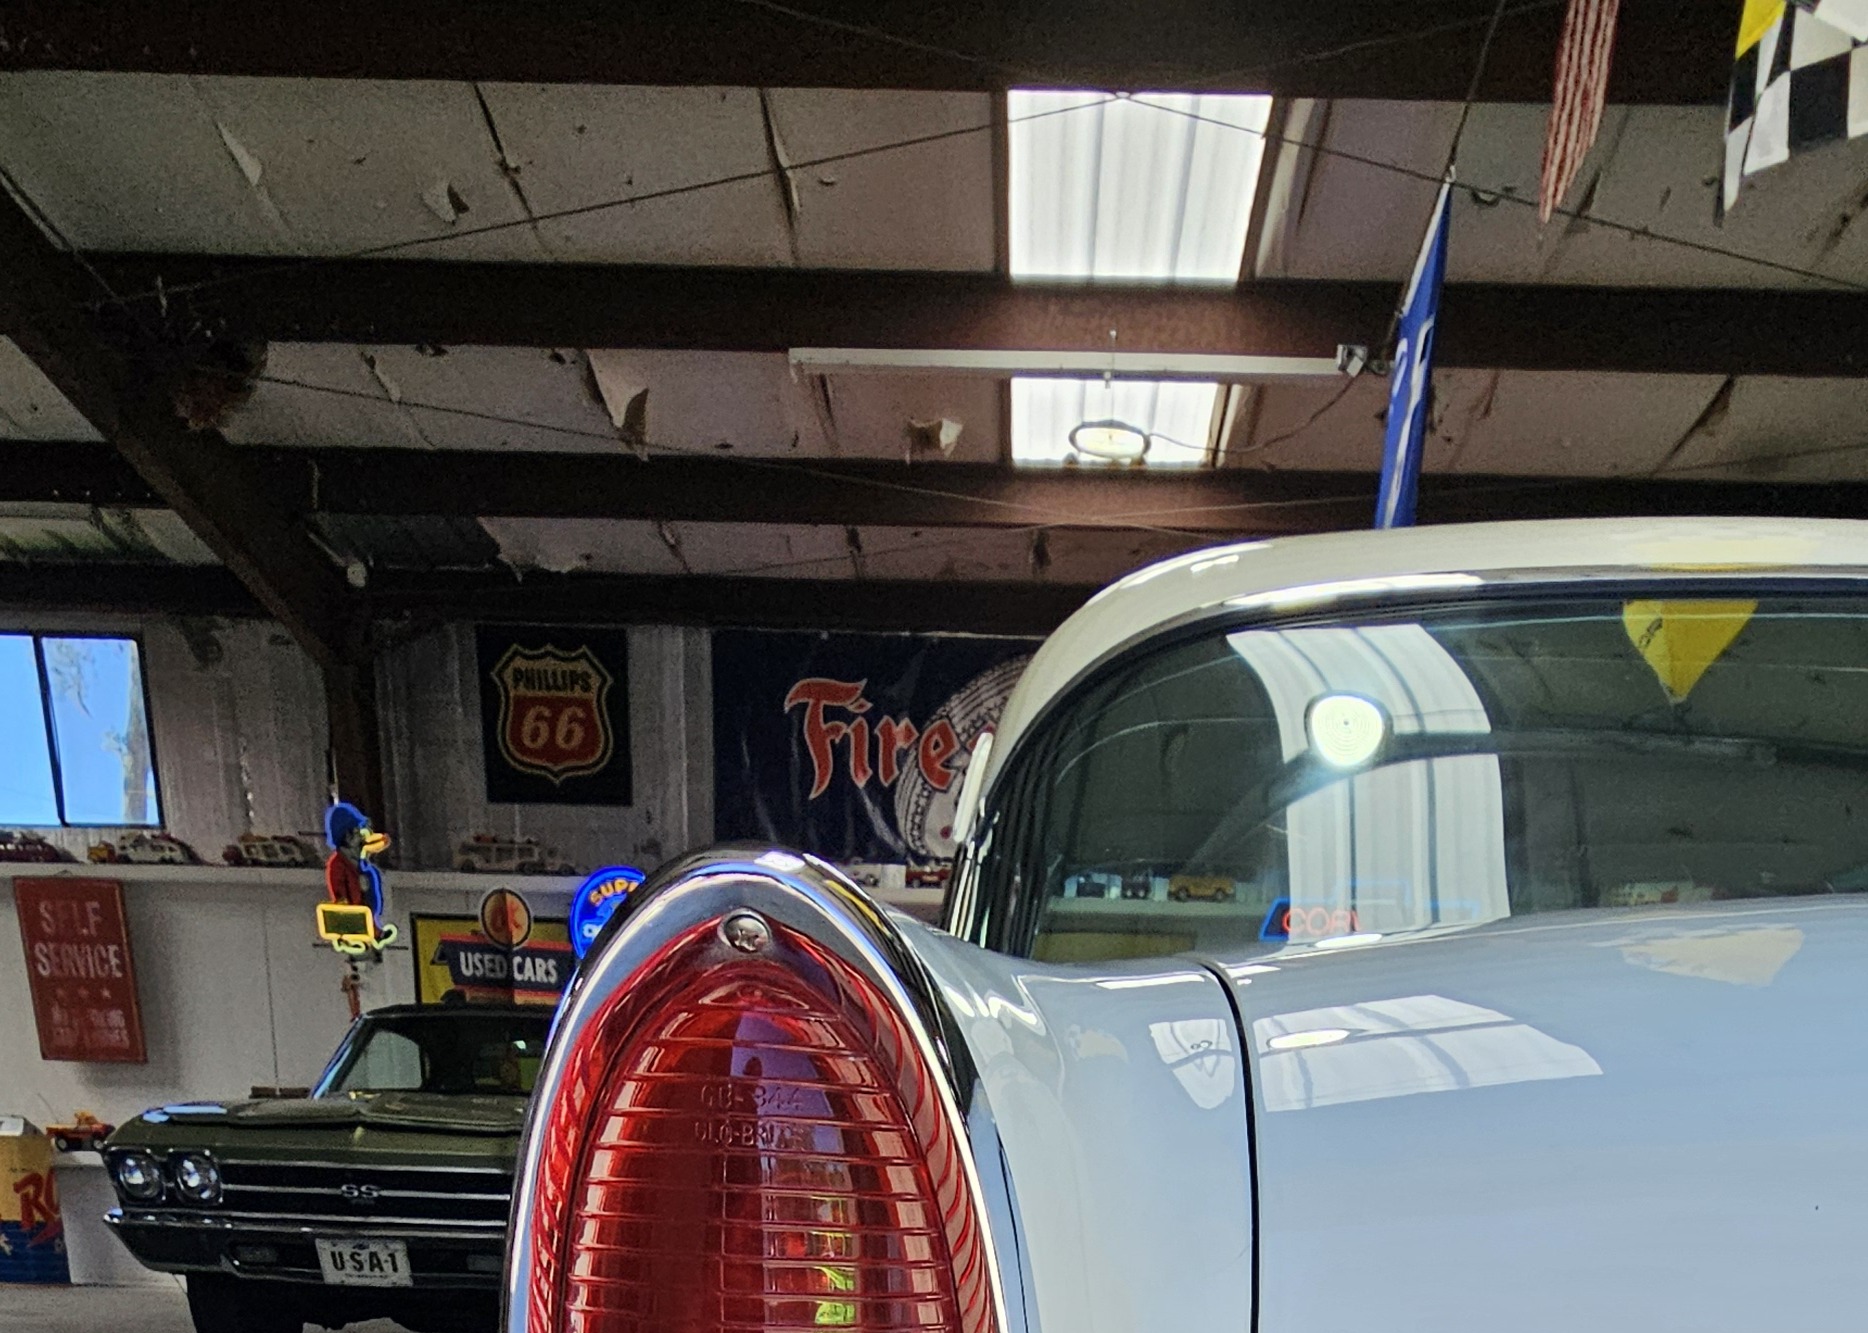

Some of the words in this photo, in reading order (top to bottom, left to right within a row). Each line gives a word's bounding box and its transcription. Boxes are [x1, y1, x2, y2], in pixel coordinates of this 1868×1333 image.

[511, 666, 592, 694] PHILLIPS
[521, 704, 587, 750] 66
[34, 942, 123, 979] SERVICE
[459, 951, 508, 980] USED
[512, 956, 559, 985] CARS
[340, 1183, 380, 1198] SS
